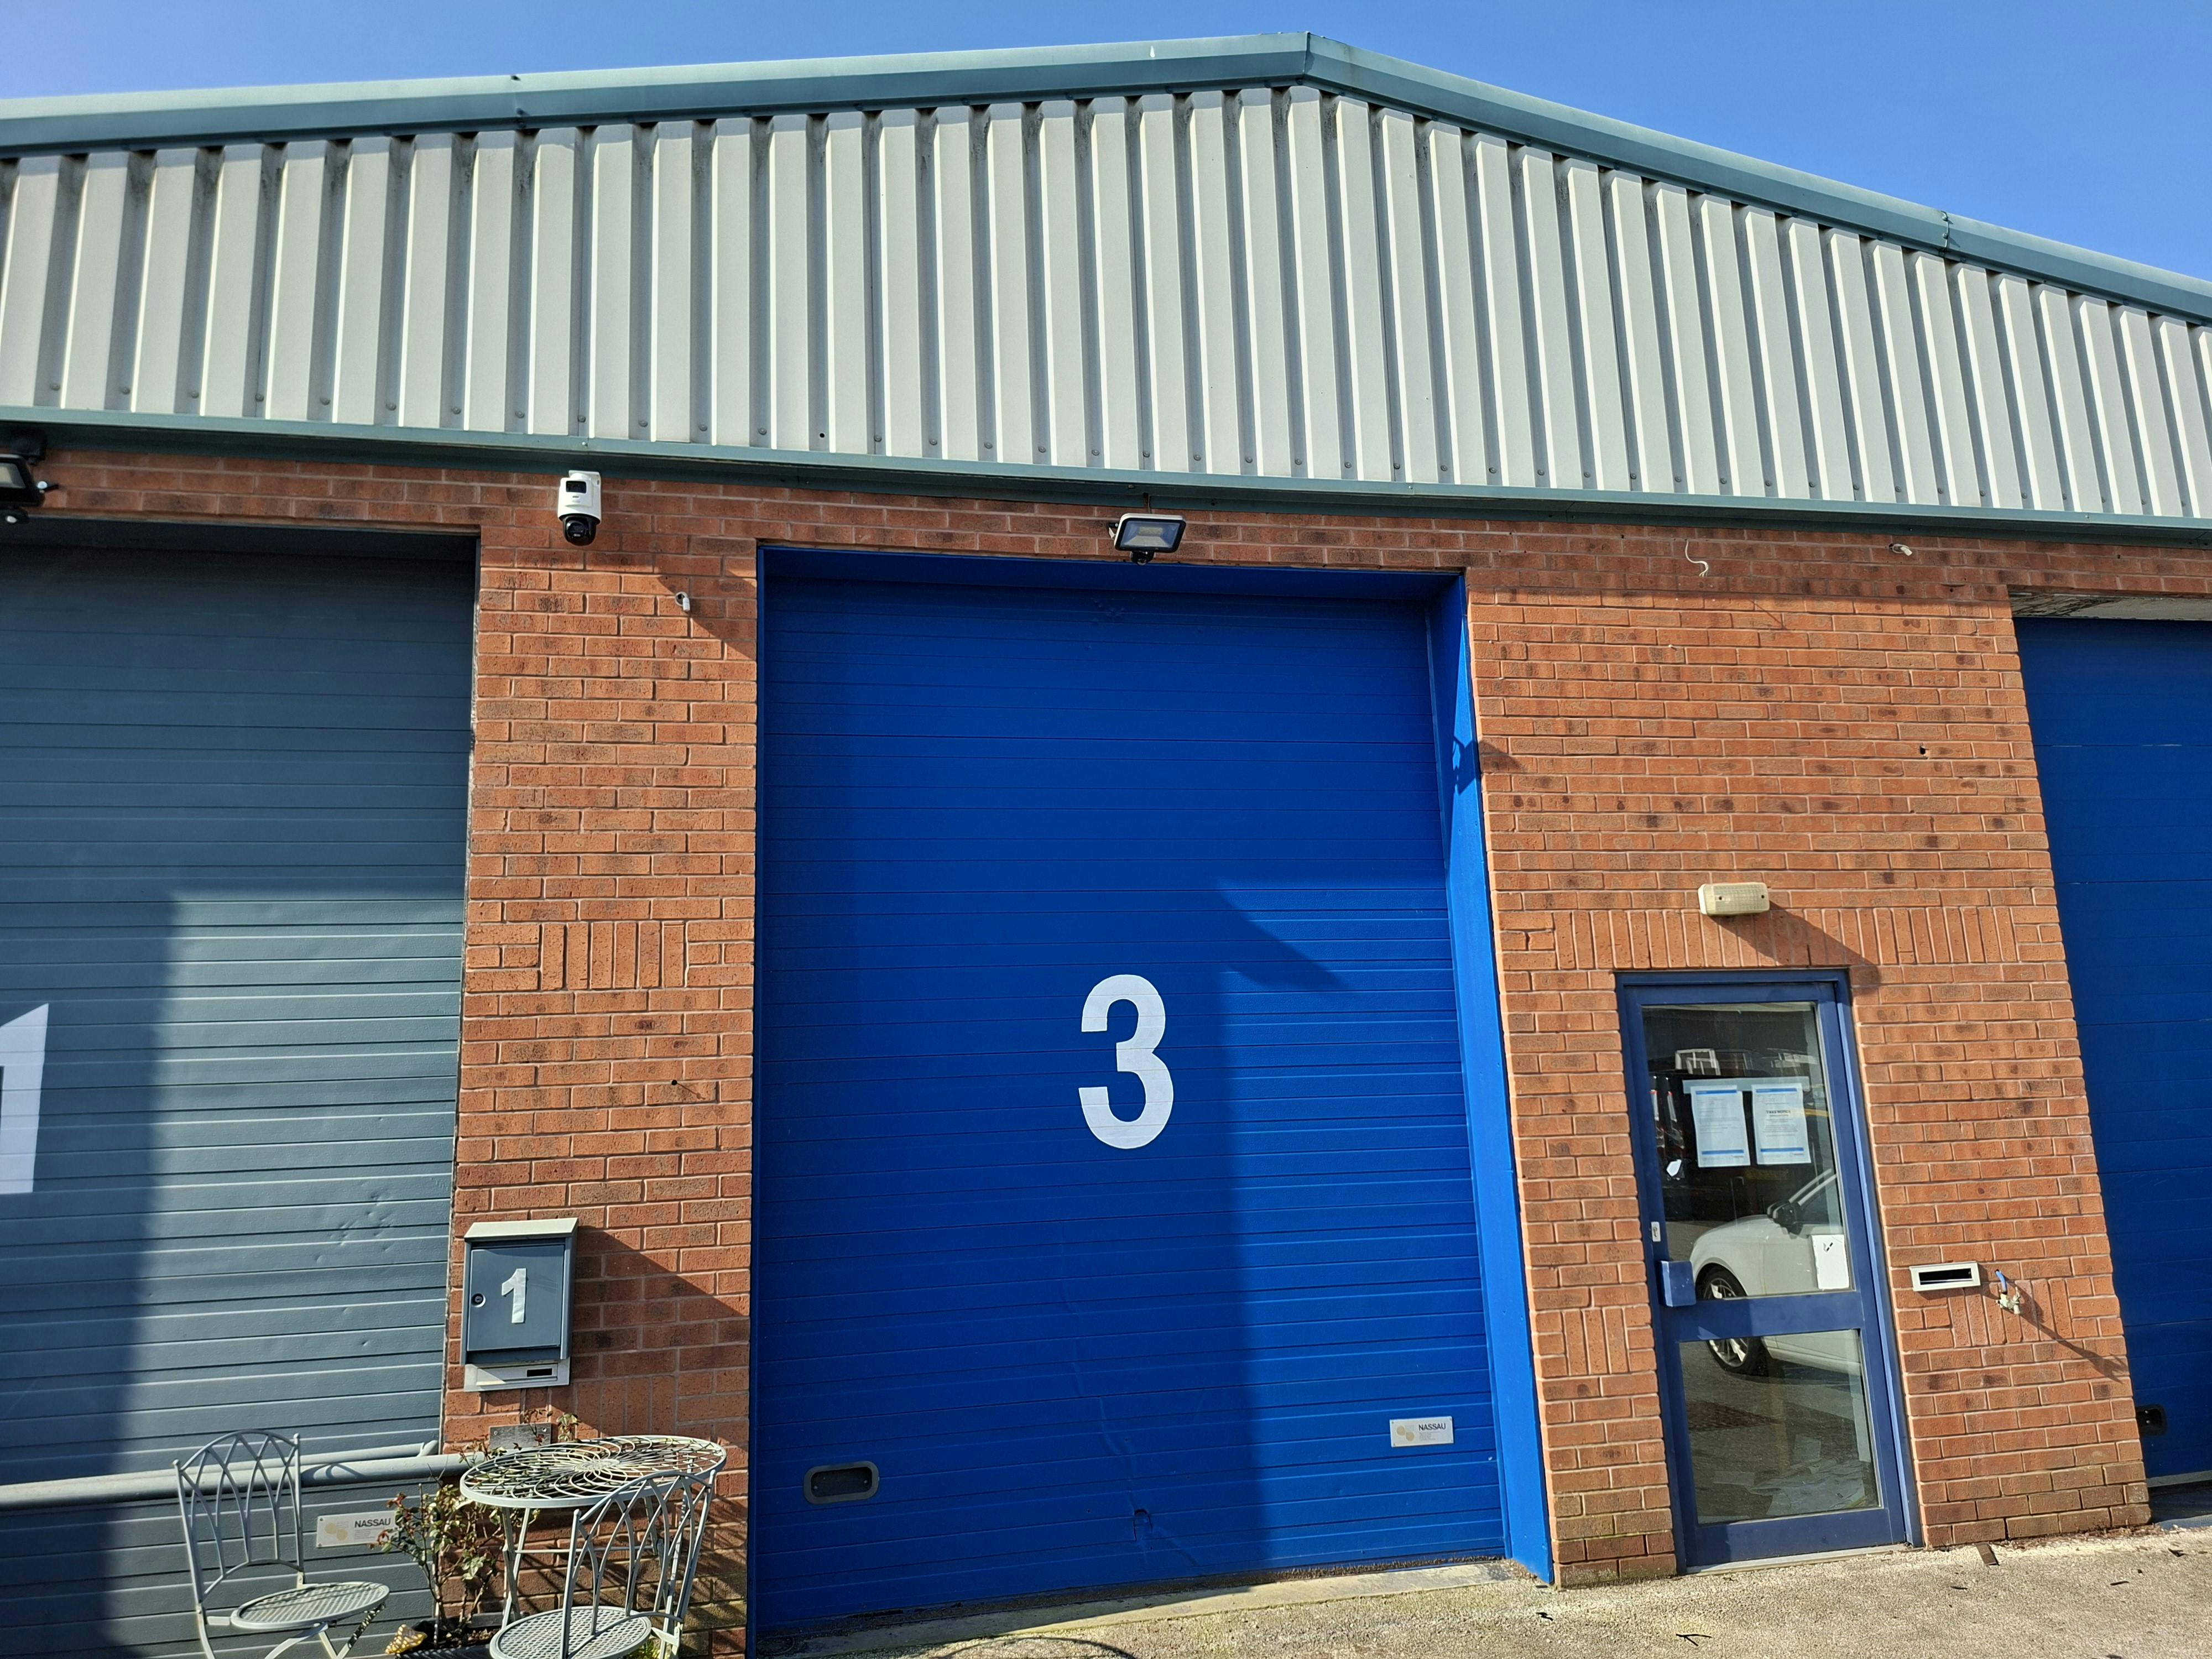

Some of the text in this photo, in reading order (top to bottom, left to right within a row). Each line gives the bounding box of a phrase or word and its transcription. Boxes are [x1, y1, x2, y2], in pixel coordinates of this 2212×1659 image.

[1078, 974, 1173, 1149] 3
[502, 1268, 526, 1323] 1
[1418, 1423, 1446, 1431] NASSAU
[354, 1518, 391, 1528] NASSAU
